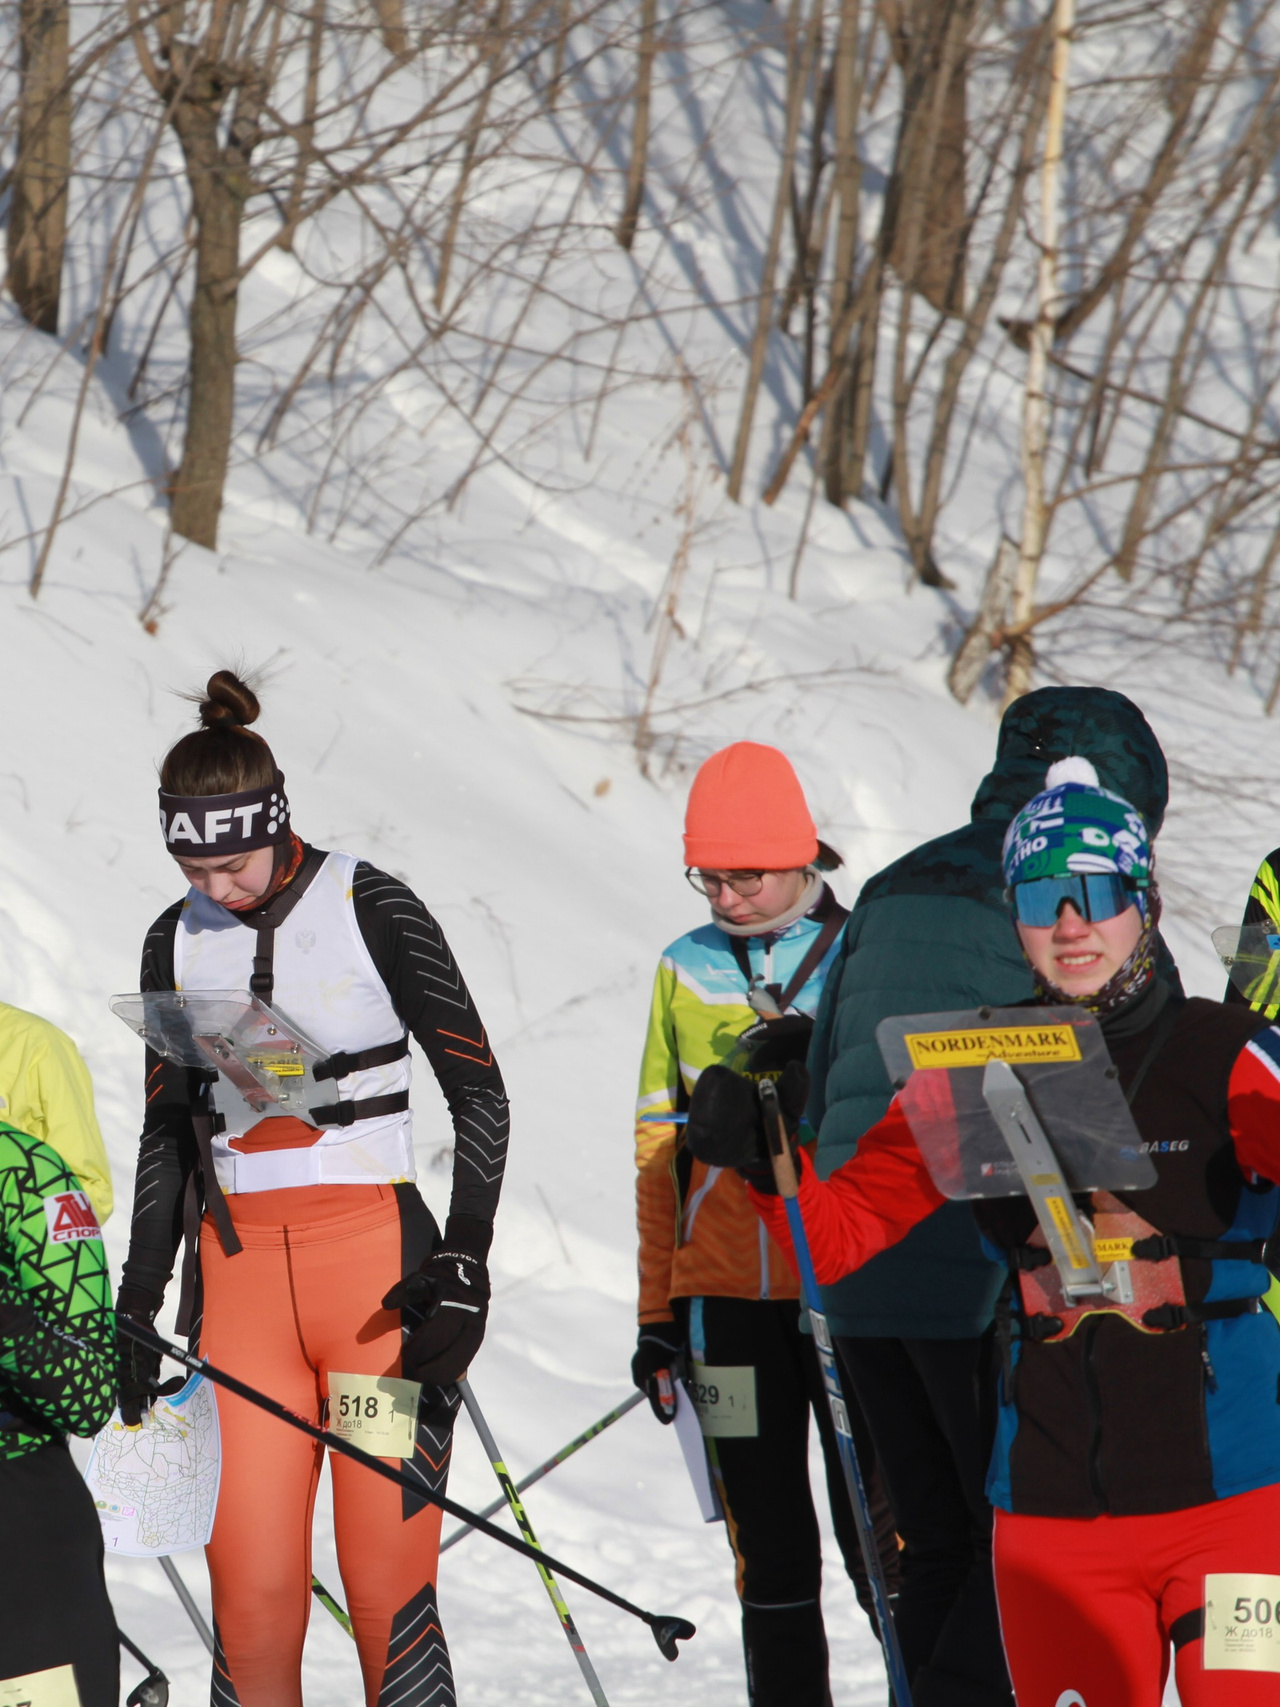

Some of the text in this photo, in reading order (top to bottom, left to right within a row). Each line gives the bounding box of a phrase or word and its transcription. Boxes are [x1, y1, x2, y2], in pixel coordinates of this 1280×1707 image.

[915, 1032, 1068, 1054] NORDENMARK
[339, 1394, 379, 1419] 518
[388, 1409, 395, 1423] 1
[342, 1419, 362, 1429] до18
[1233, 1596, 1280, 1625] 50
[1225, 1626, 1273, 1639] Ж до18
